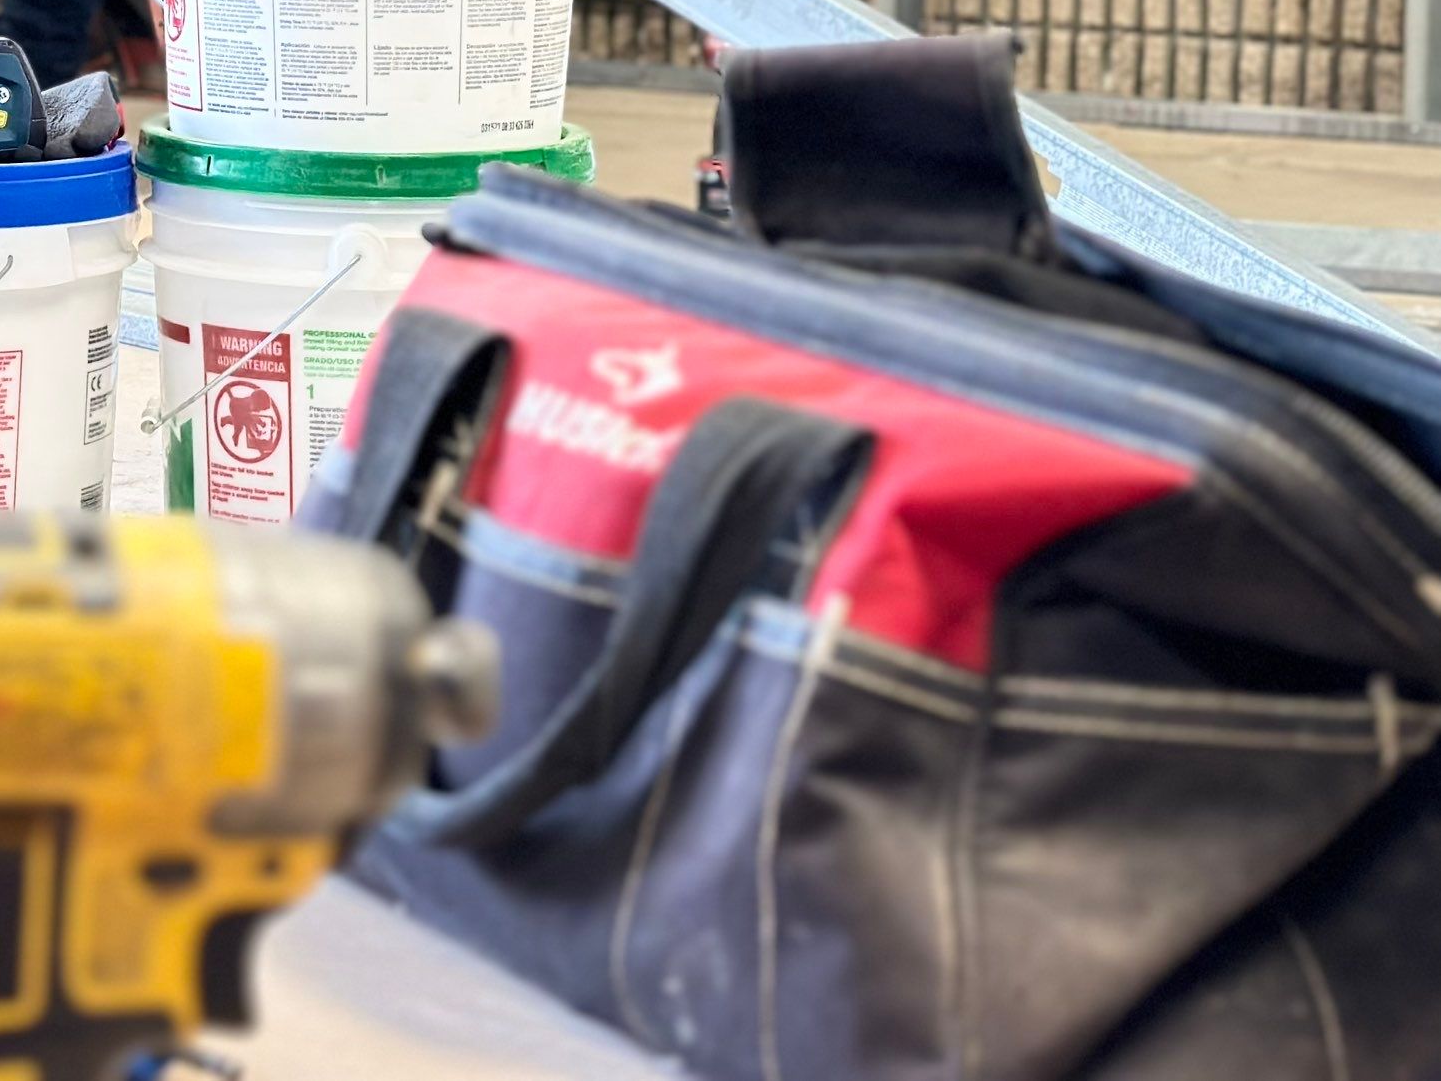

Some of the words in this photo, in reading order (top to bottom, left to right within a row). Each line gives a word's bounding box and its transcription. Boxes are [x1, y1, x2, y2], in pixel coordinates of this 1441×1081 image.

[280, 41, 311, 49] Aplicación
[303, 329, 367, 338] PROFESSIONAL
[303, 356, 355, 365] GRADO/USO
[306, 384, 314, 400] 1
